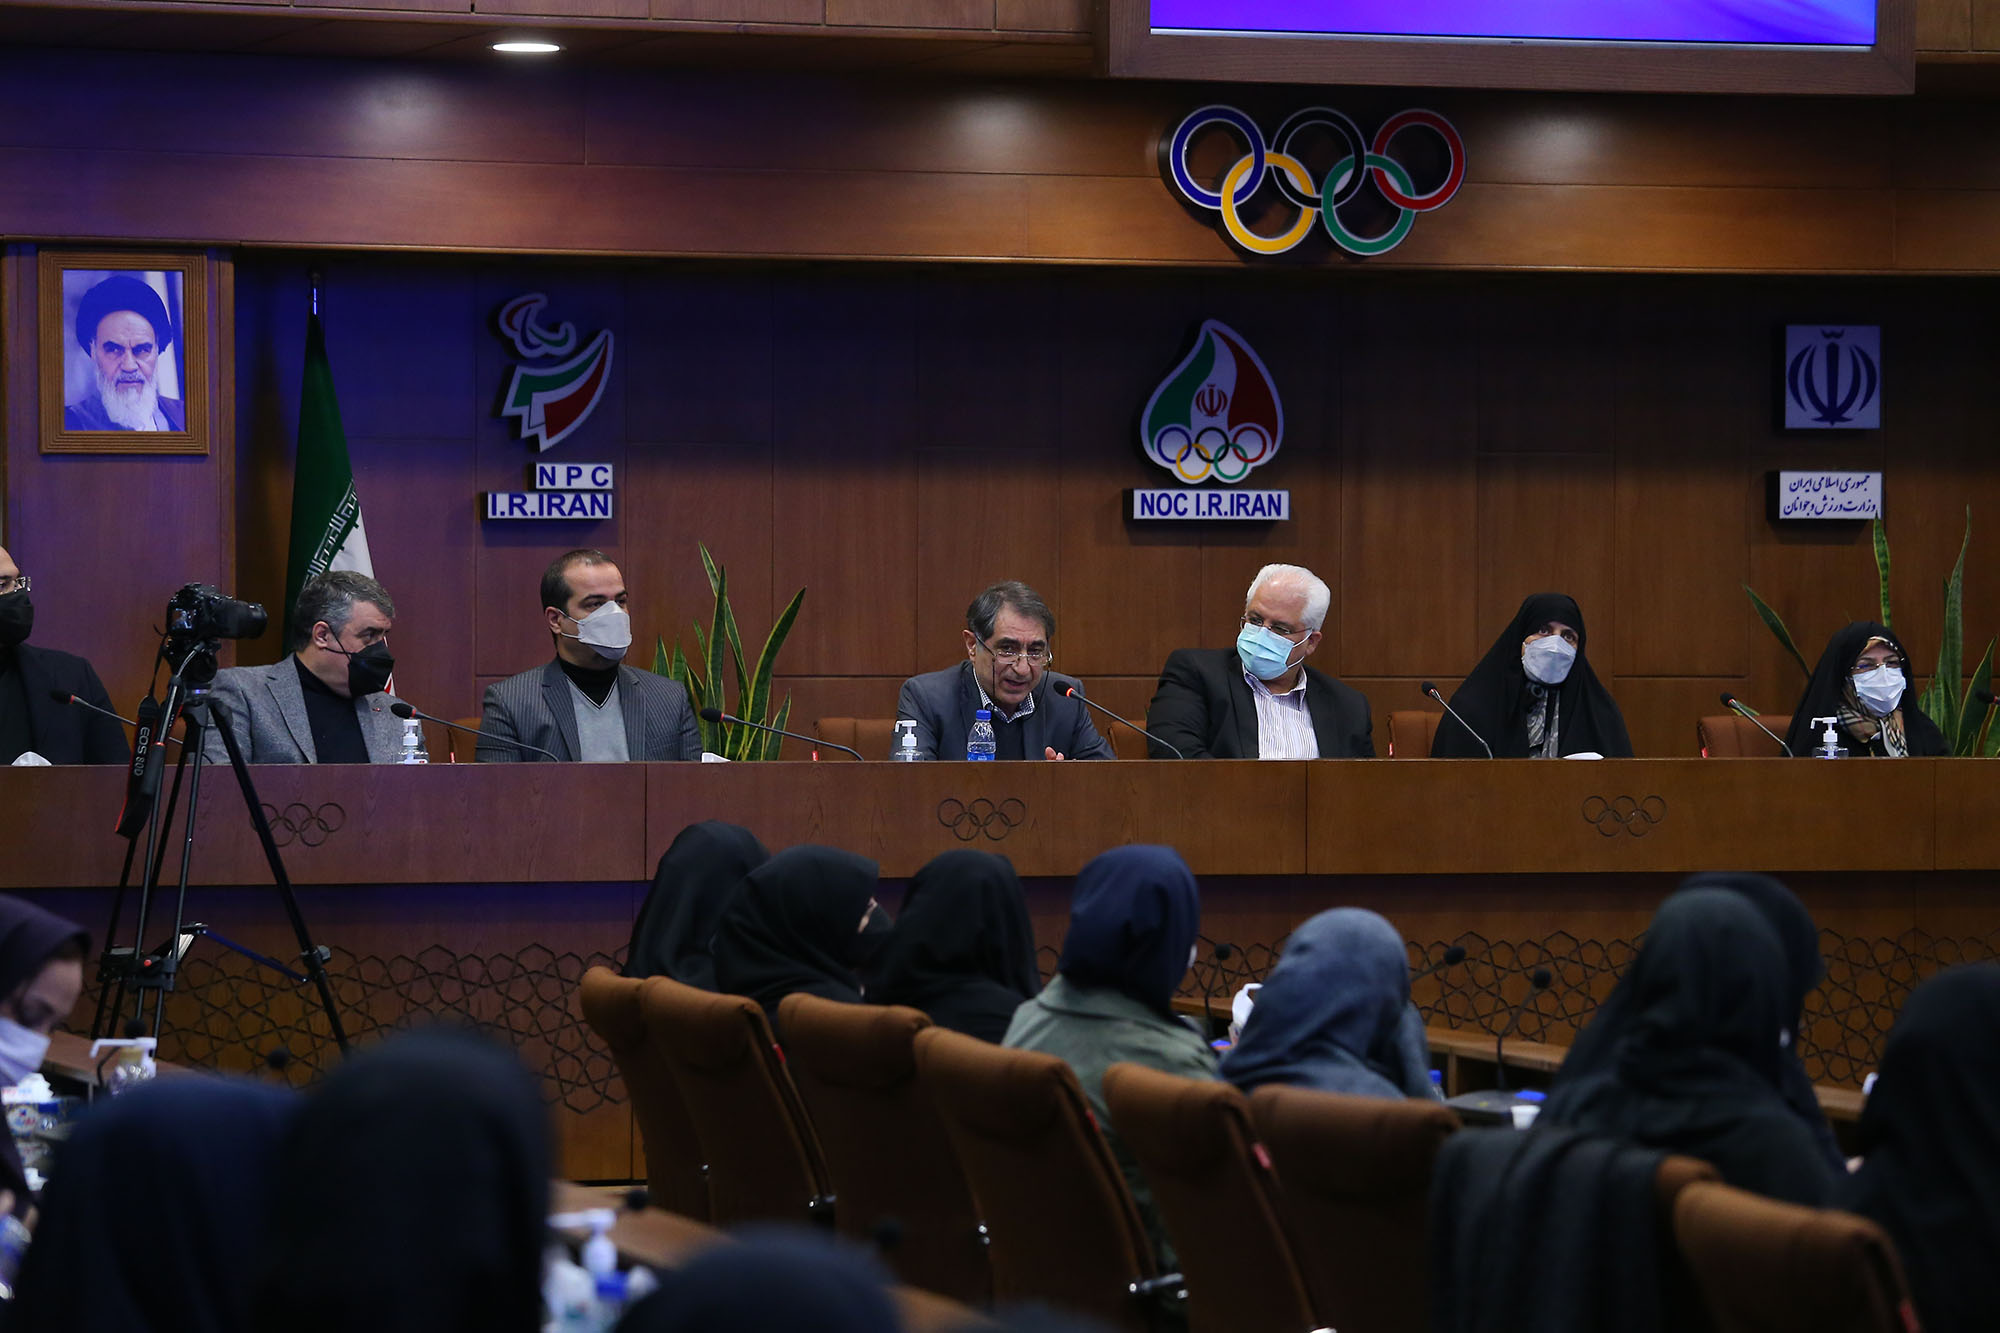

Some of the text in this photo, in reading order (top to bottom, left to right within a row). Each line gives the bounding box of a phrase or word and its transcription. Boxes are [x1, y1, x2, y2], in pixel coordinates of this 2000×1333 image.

[1789, 478, 1812, 492] ایران
[491, 493, 609, 516] I.R.IRAN
[1140, 493, 1282, 516] NOC I.R.IRAN
[1842, 499, 1876, 512] وزارت
[137, 727, 150, 754] EOS
